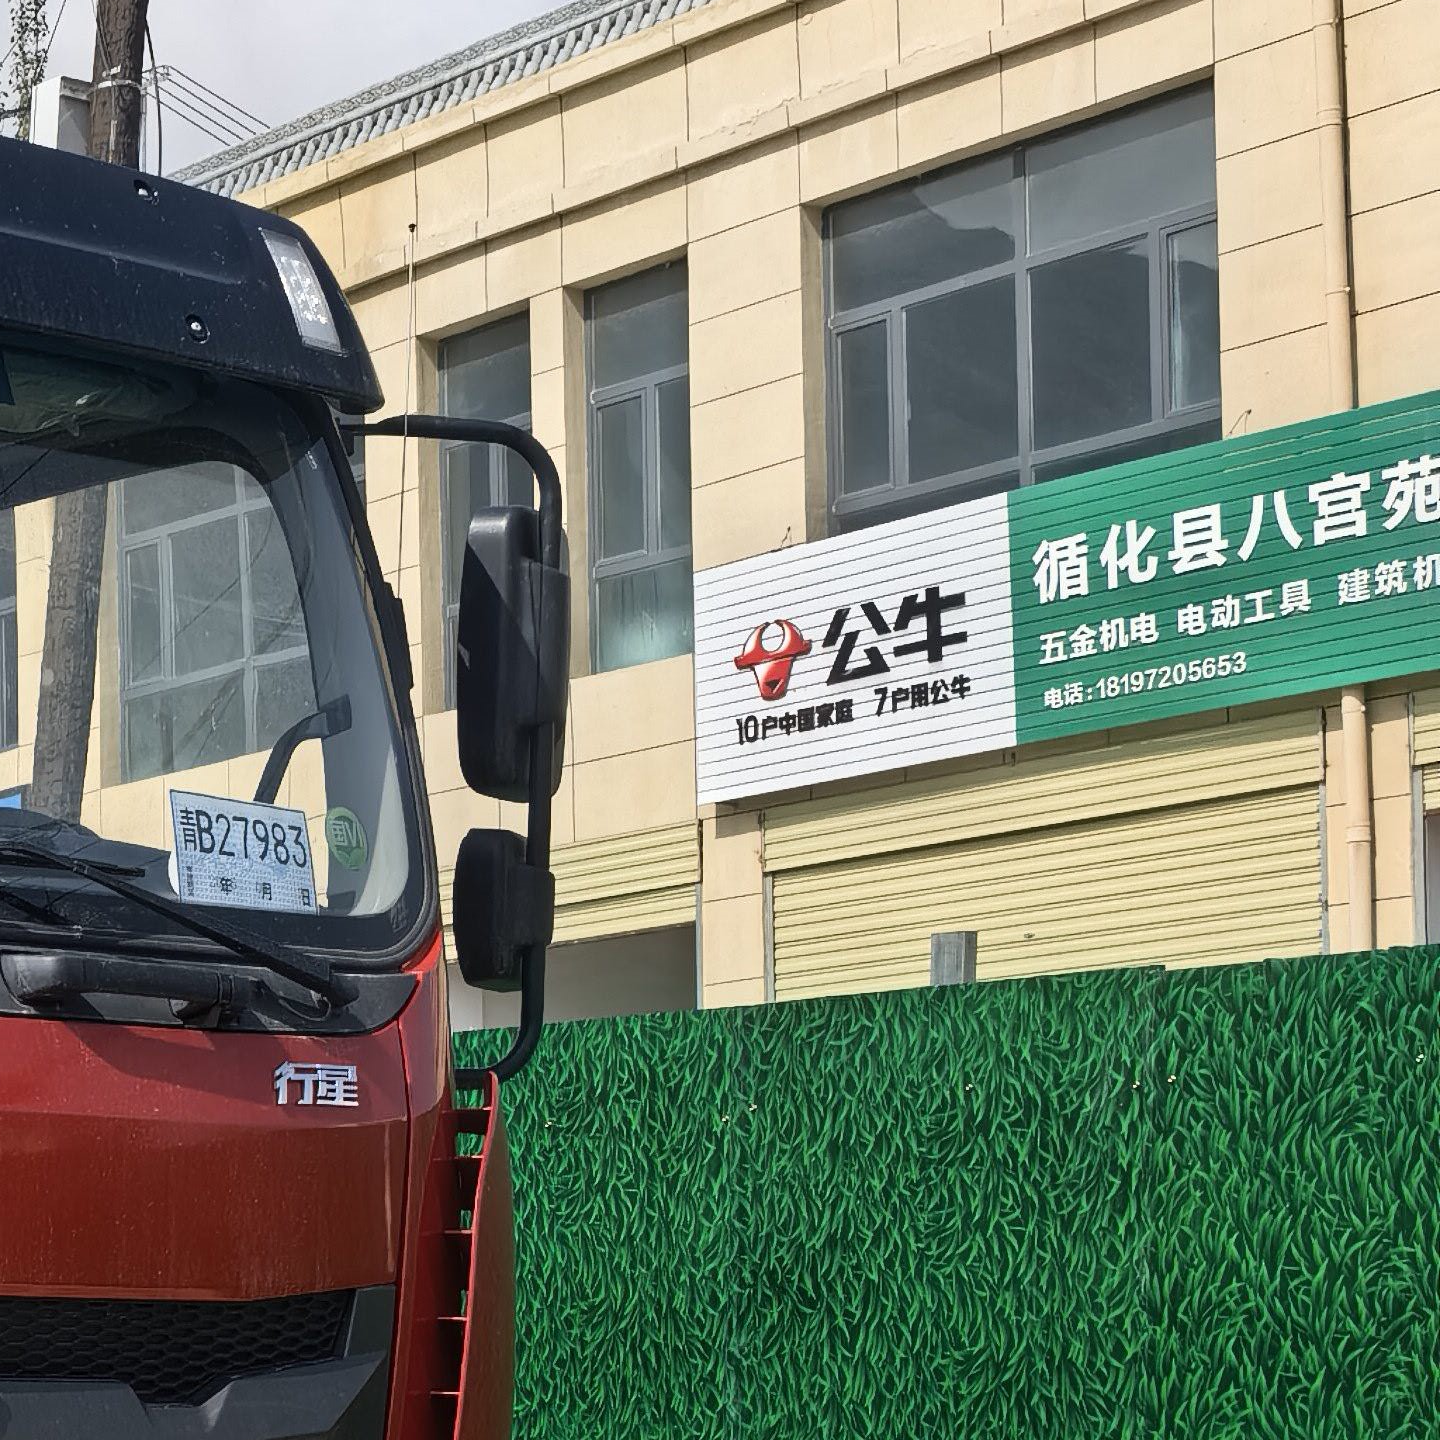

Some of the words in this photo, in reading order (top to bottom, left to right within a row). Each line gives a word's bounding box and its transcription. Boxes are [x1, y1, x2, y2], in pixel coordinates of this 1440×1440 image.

[822, 586, 968, 686] 公牛
[1038, 612, 1160, 666] 五金机电
[1177, 578, 1312, 638] 电动工具
[735, 698, 855, 745] 10户中国家庭
[874, 674, 971, 717] 7户用公牛
[180, 807, 307, 869] 青B27983
[273, 1061, 359, 1107] 行星
